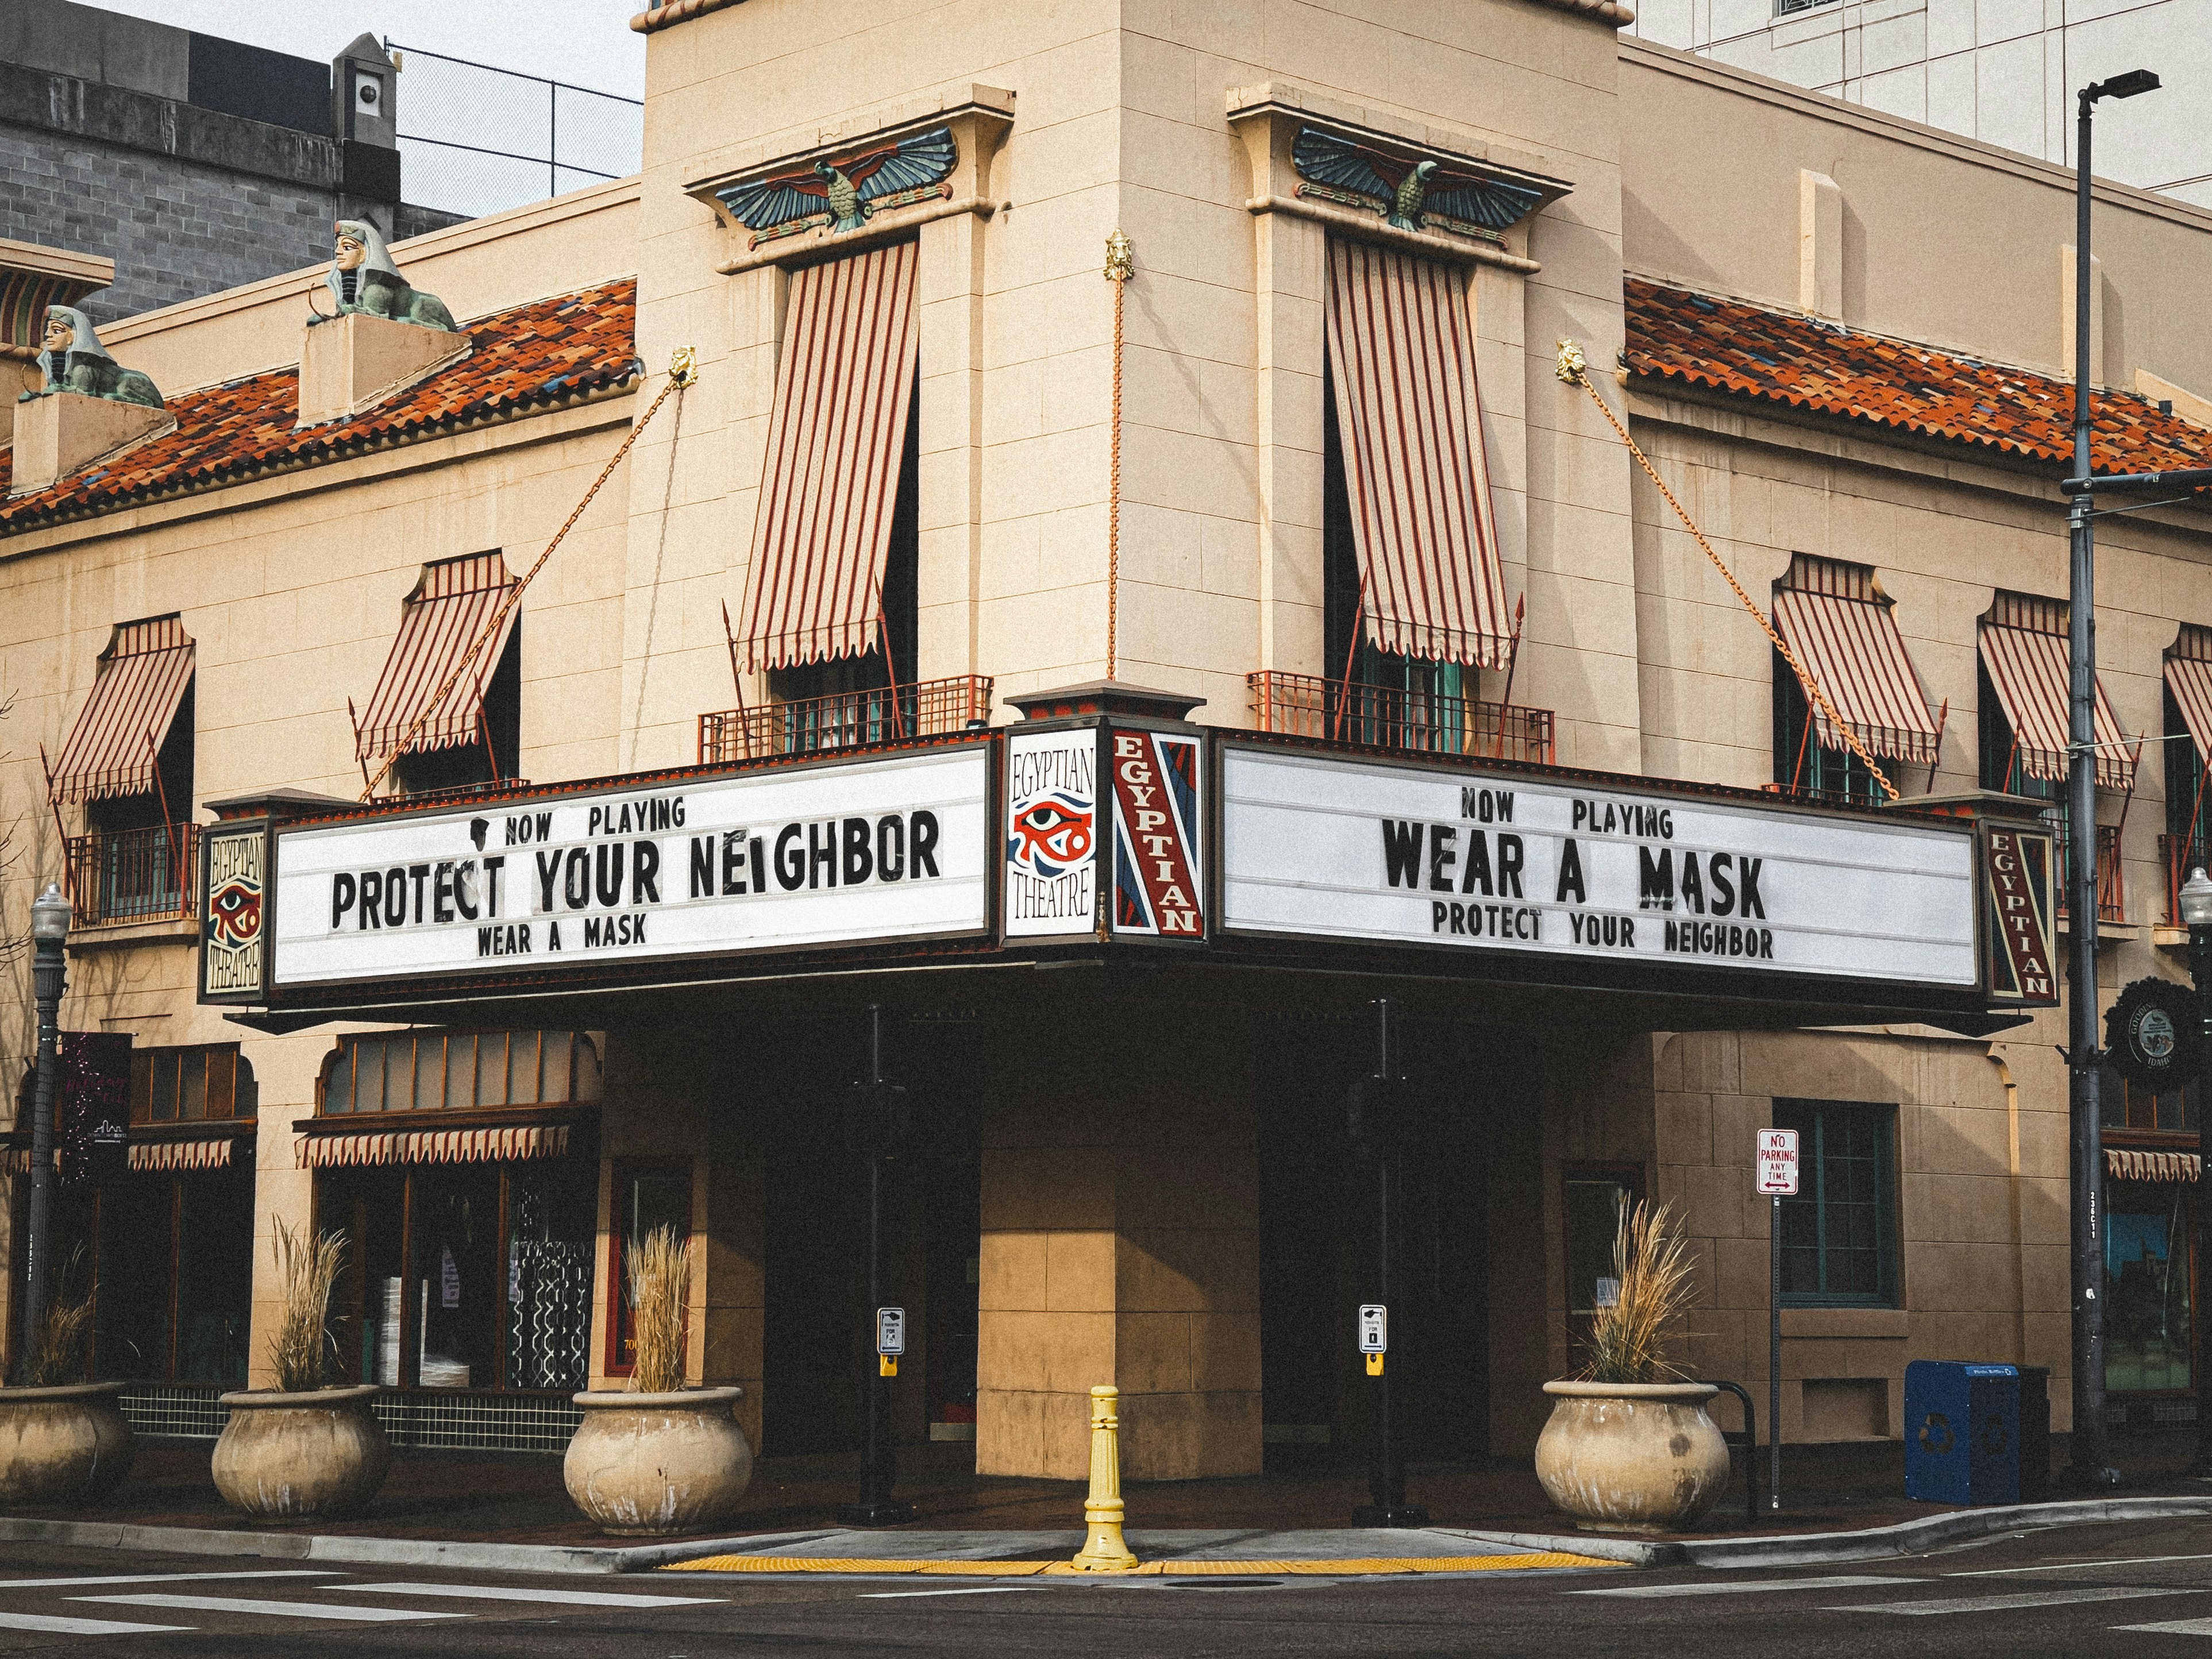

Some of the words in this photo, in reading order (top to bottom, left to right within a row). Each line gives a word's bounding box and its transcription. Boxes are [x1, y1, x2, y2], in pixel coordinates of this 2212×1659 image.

[1012, 747, 1094, 803] EGYPTIAN
[507, 813, 551, 845] NOW
[589, 797, 684, 835] PLAYING
[1115, 736, 1197, 932] EGYPTIAN
[1462, 788, 1513, 823] NOW
[1573, 800, 1673, 839] PLAYING
[211, 836, 263, 887] EGYPTIAN
[333, 856, 504, 929] PROTECT
[537, 841, 659, 911] YOUR
[691, 811, 939, 897] NEIGHBOR
[1382, 820, 1523, 898] WEAR
[1557, 839, 1585, 903] A
[1640, 846, 1765, 919] MASK
[1013, 867, 1089, 919] THEATRE
[1991, 834, 2048, 994] EGYPTIAN
[479, 924, 530, 956] WEAR
[550, 922, 560, 950] A
[585, 914, 645, 947] MASK
[1433, 902, 1541, 940] PROTECT
[1570, 913, 1634, 947] YOUR
[1666, 921, 1772, 958] NEIGHBOR
[210, 943, 259, 989] THEATRE
[1761, 1149, 1795, 1162] PARKING
[1771, 1136, 1785, 1147] NO
[1768, 1172, 1787, 1180] TIME
